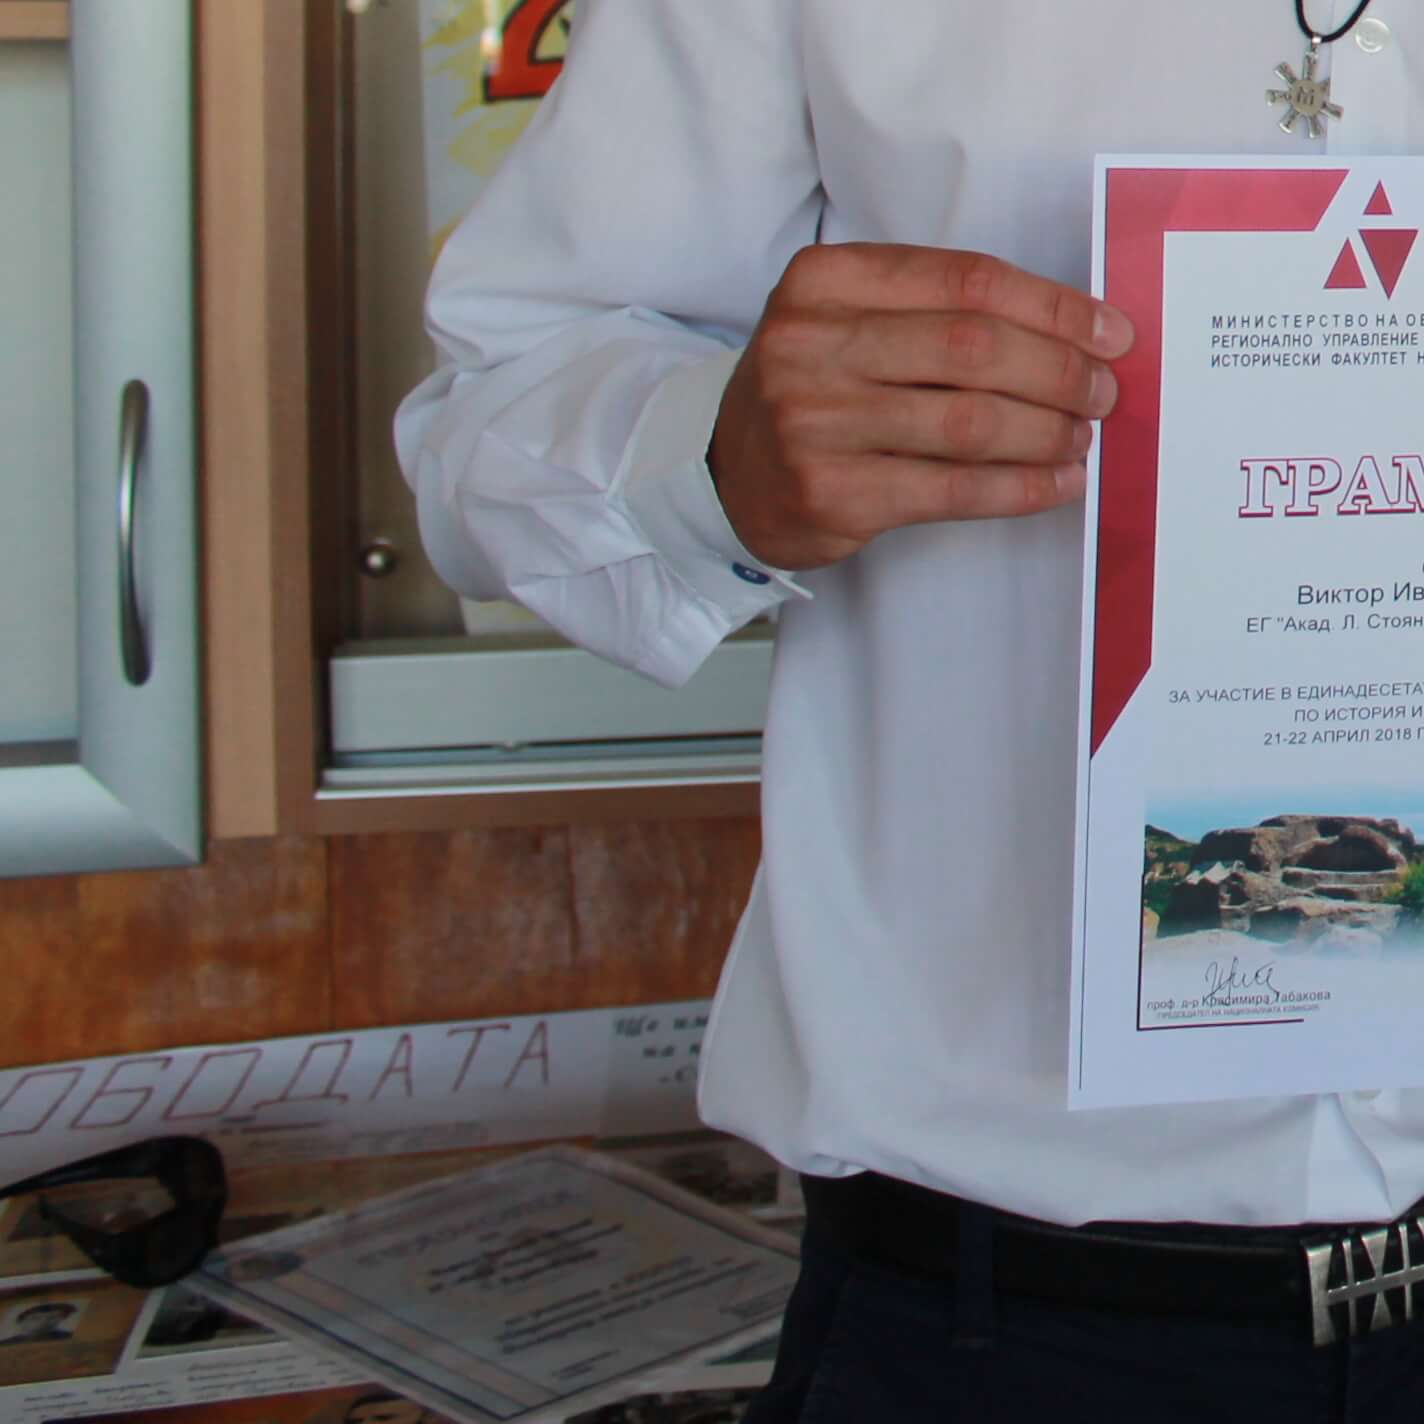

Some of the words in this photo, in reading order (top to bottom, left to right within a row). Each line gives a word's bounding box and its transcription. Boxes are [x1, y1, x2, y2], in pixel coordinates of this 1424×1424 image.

[1211, 313, 1369, 329] МИНИСТЕРСТВО
[1375, 313, 1399, 328] НА
[1211, 333, 1313, 349] РЕГИОНАЛНО
[1322, 331, 1419, 347] УПРАВЛЕНИЕ
[1210, 352, 1321, 369] ИСТОРИЧЕСКИ
[1330, 351, 1408, 366] ФАКУЛТЕТ
[1297, 584, 1385, 608] Виктор
[1246, 616, 1273, 633] ЕГ
[1168, 689, 1191, 704] ЗА
[1196, 687, 1276, 703] УЧАСТИЕ
[1281, 685, 1292, 700] В
[1293, 708, 1320, 723] ПО
[1324, 705, 1407, 721] ИСТОРИЯ
[1411, 704, 1424, 718] И
[1263, 731, 1307, 746] 21-22
[1311, 728, 1370, 744] АПРИЛ
[1374, 727, 1412, 742] 2018
